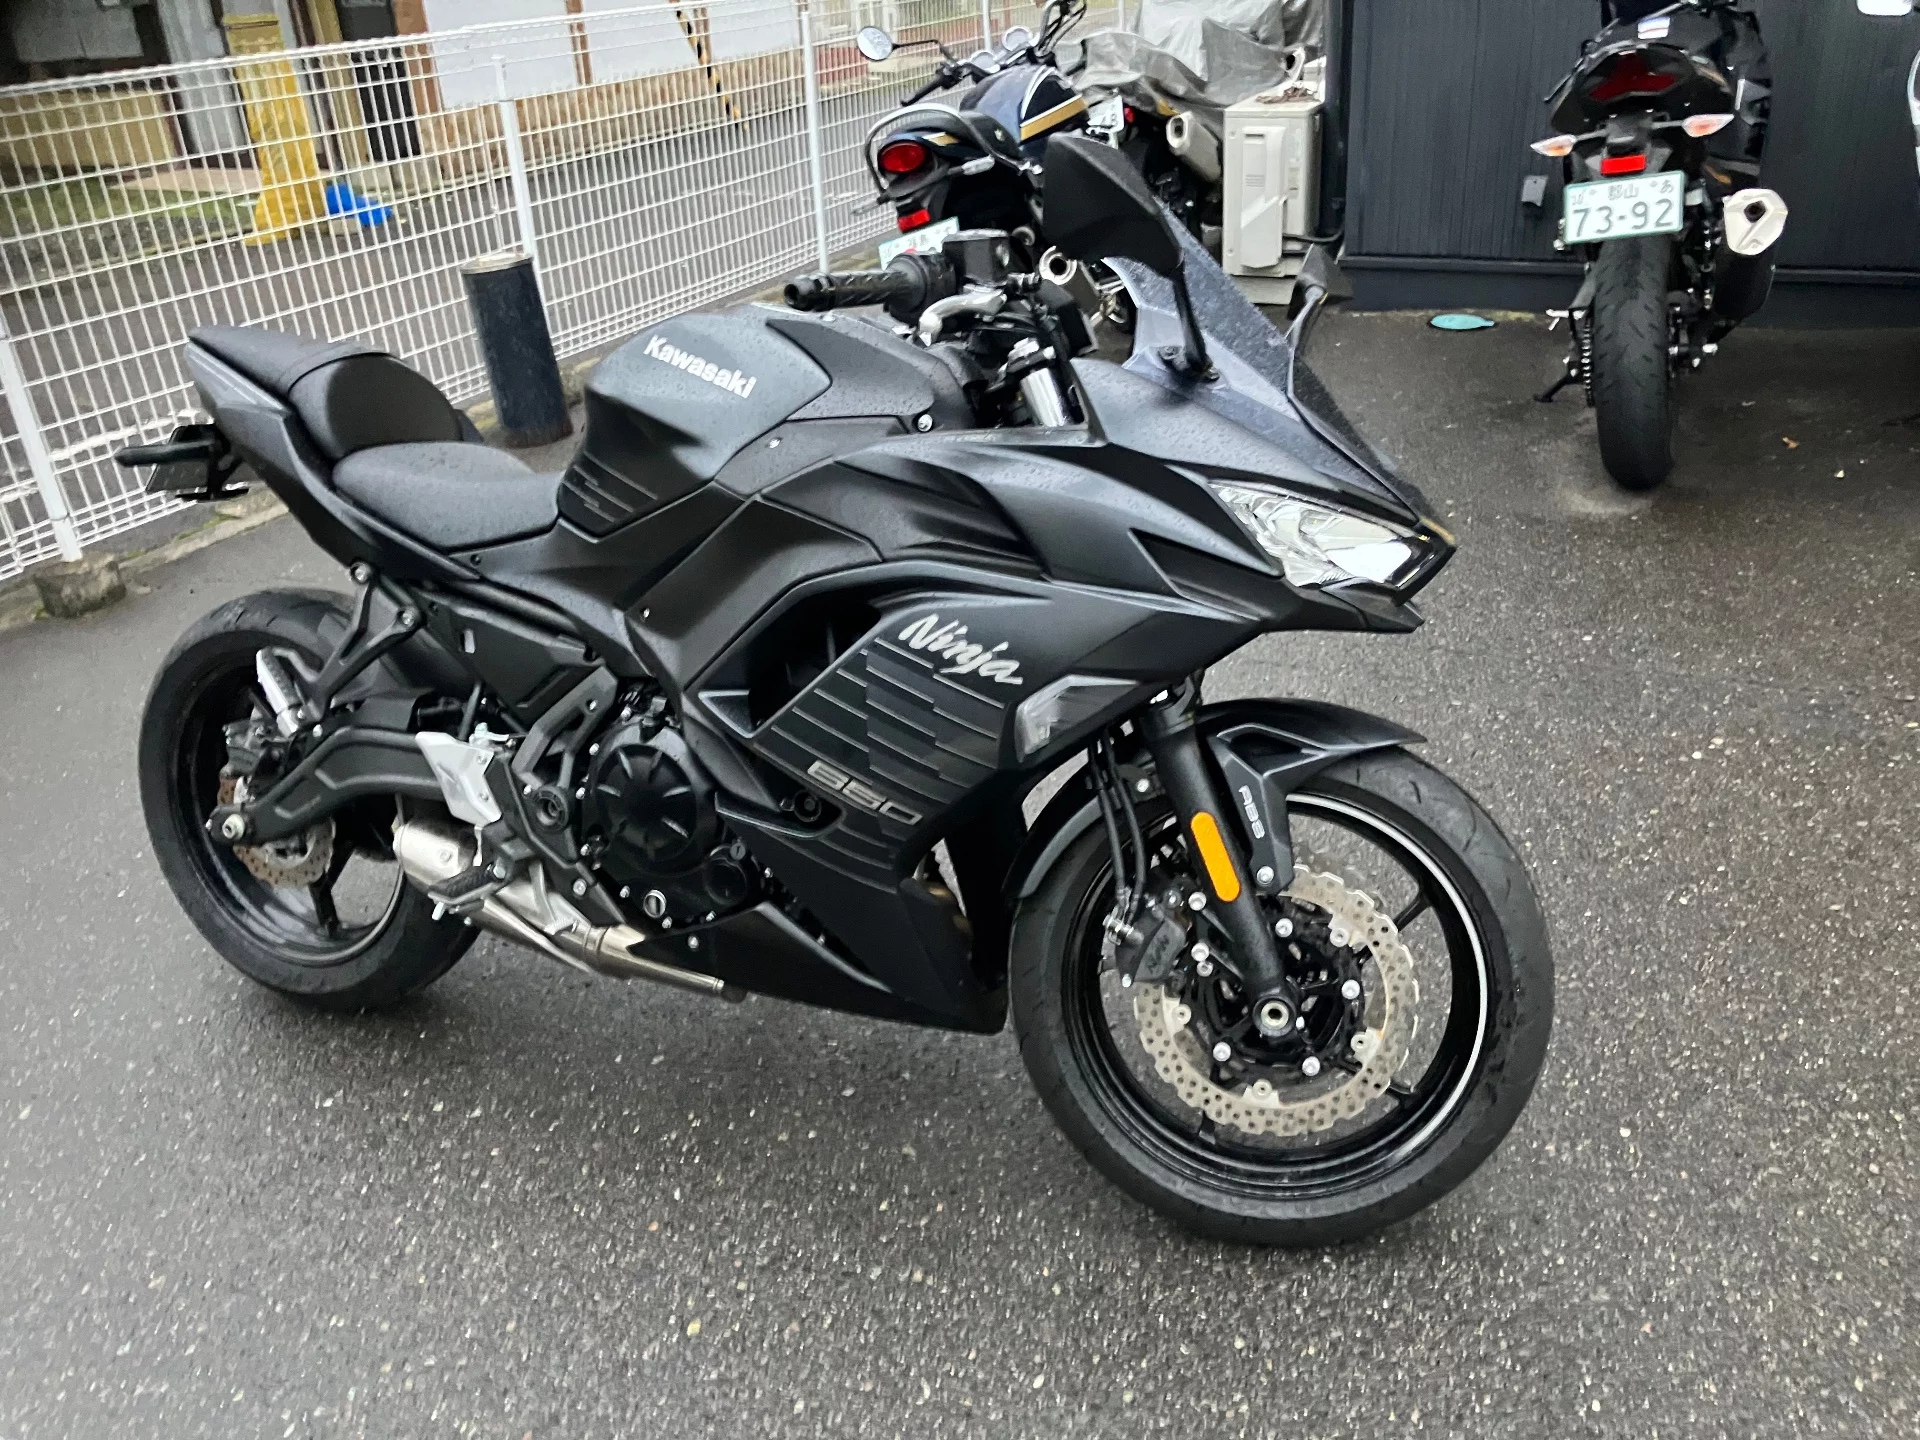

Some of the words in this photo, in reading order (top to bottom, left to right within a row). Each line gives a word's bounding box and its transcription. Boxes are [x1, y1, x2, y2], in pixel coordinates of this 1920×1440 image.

[1573, 198, 1673, 238] 73-92
[643, 334, 757, 399] Kawasaki
[898, 613, 1023, 685] Ninja
[807, 760, 923, 826] 650
[1238, 785, 1265, 839] ABS
